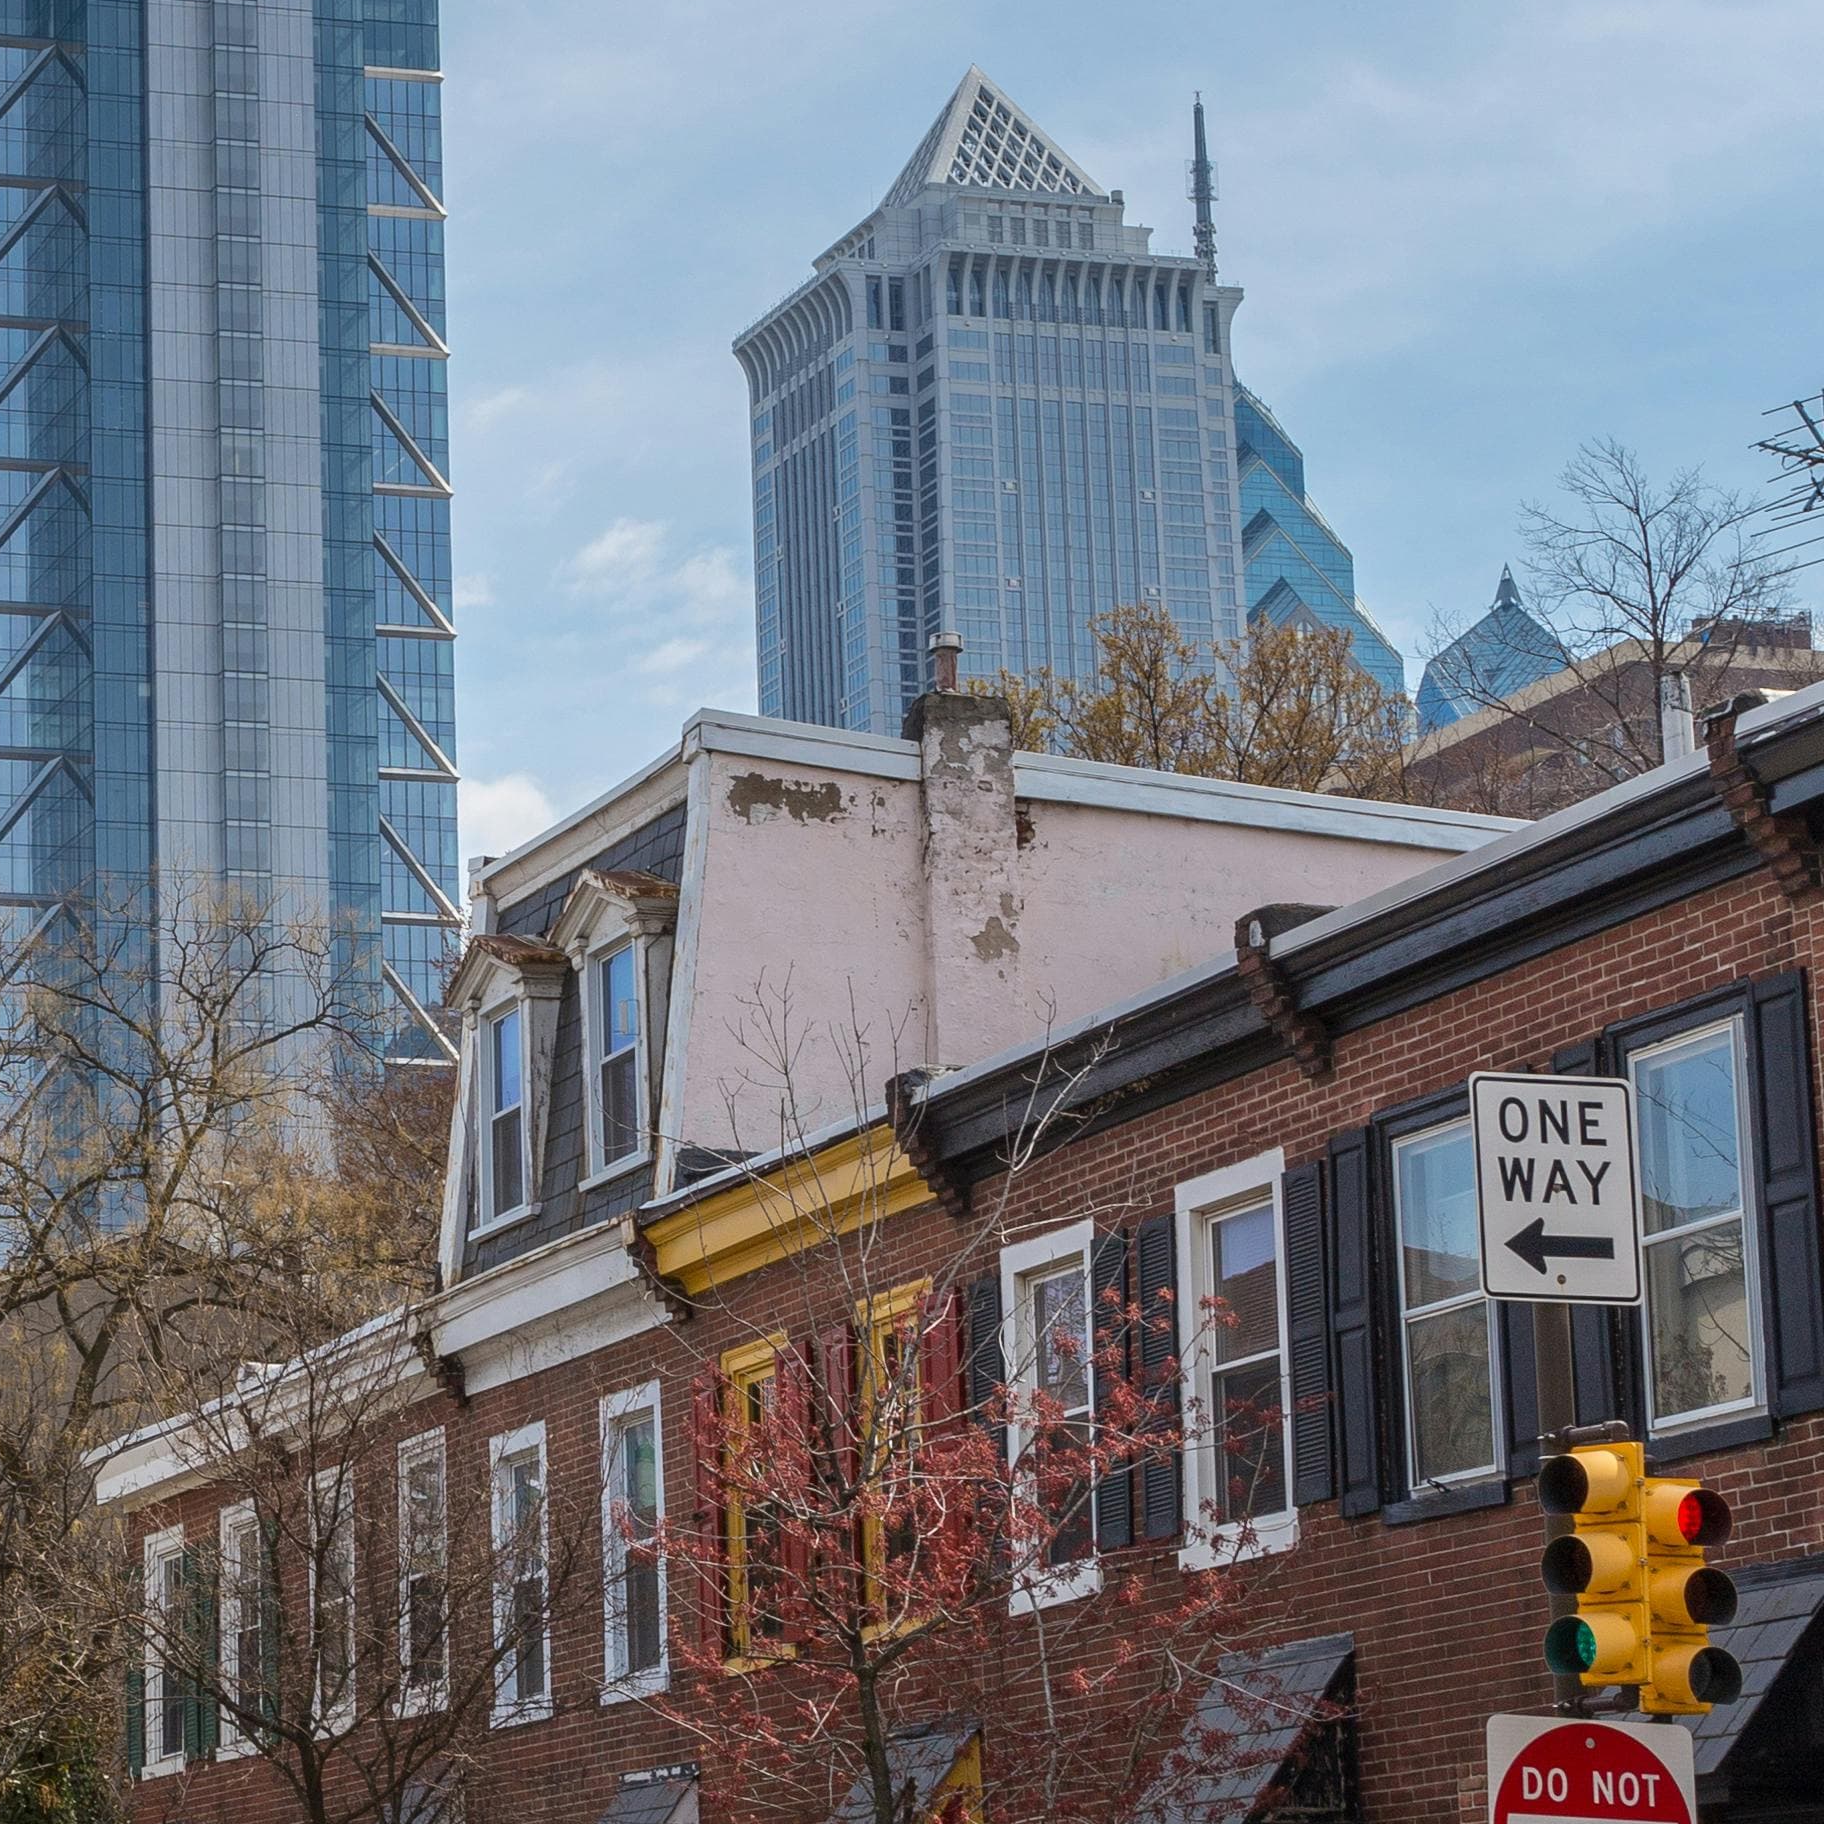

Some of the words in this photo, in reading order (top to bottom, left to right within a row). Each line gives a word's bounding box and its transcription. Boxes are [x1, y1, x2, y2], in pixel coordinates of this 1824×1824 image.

[1498, 1096, 1608, 1147] ONE
[1498, 1156, 1612, 1206] WAY
[1521, 1766, 1569, 1803] DO
[1592, 1770, 1661, 1808] NOT
